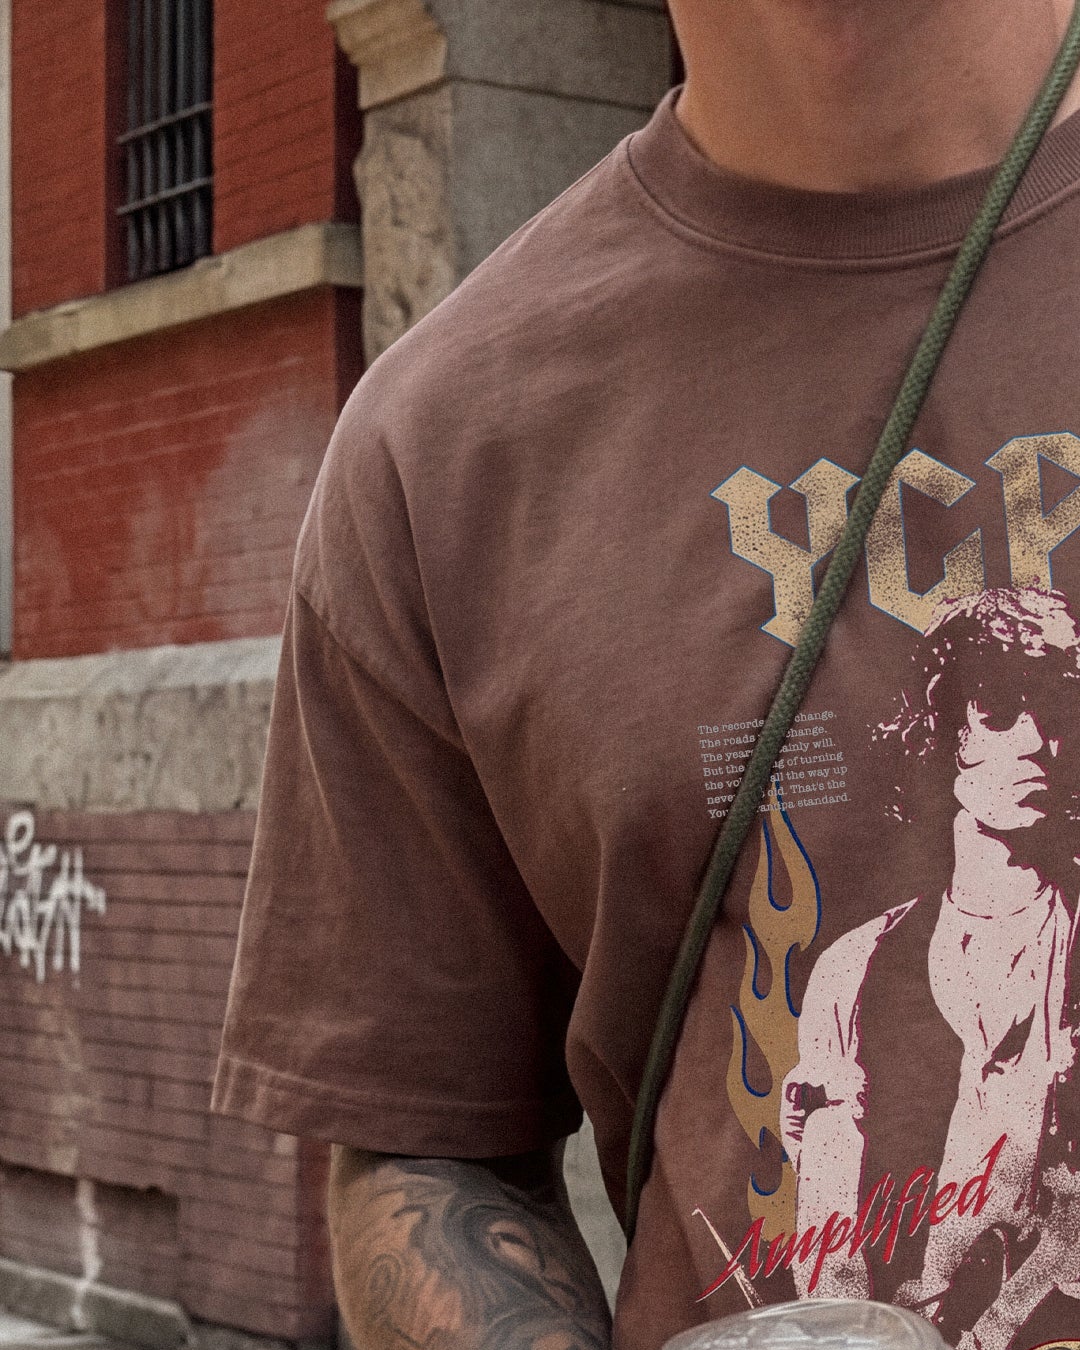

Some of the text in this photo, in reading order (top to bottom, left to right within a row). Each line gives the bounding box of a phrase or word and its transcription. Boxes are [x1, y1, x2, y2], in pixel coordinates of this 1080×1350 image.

[698, 711, 837, 735] The records change.
[700, 740, 720, 749] The
[723, 735, 755, 745] roads
[702, 753, 722, 763] The
[814, 738, 836, 749] will.
[703, 768, 723, 777] But
[726, 764, 744, 773] the
[787, 757, 799, 766] of
[800, 752, 843, 765] turning
[705, 782, 723, 791] the
[770, 772, 783, 782] all
[786, 769, 804, 781] the
[807, 768, 829, 779] way
[833, 766, 847, 776] up
[768, 787, 787, 797] old.
[790, 782, 824, 794] That's
[827, 780, 845, 789] the
[798, 794, 851, 807] standard.
[696, 1133, 1007, 1302] Amplified
